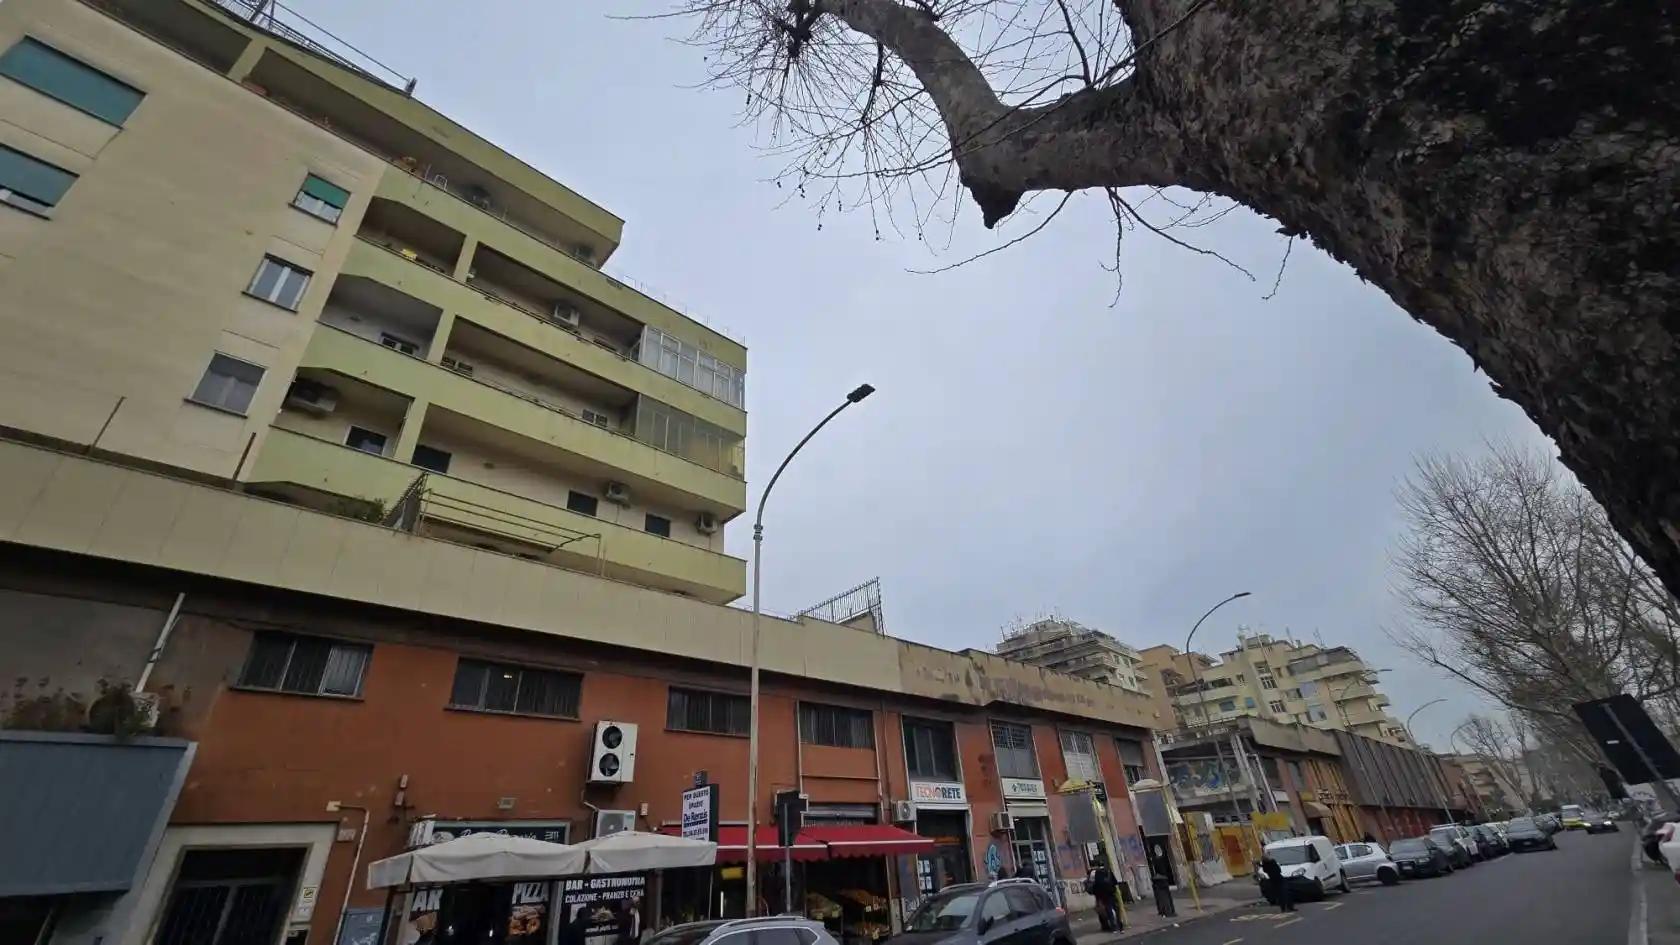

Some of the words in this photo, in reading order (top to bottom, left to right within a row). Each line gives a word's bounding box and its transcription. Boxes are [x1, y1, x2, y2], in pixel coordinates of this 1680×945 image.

[566, 879, 584, 891] BAR
[590, 876, 646, 889] GASTRONOMIA
[565, 892, 598, 903] COLAZIONE
[602, 890, 625, 900] PRANZO
